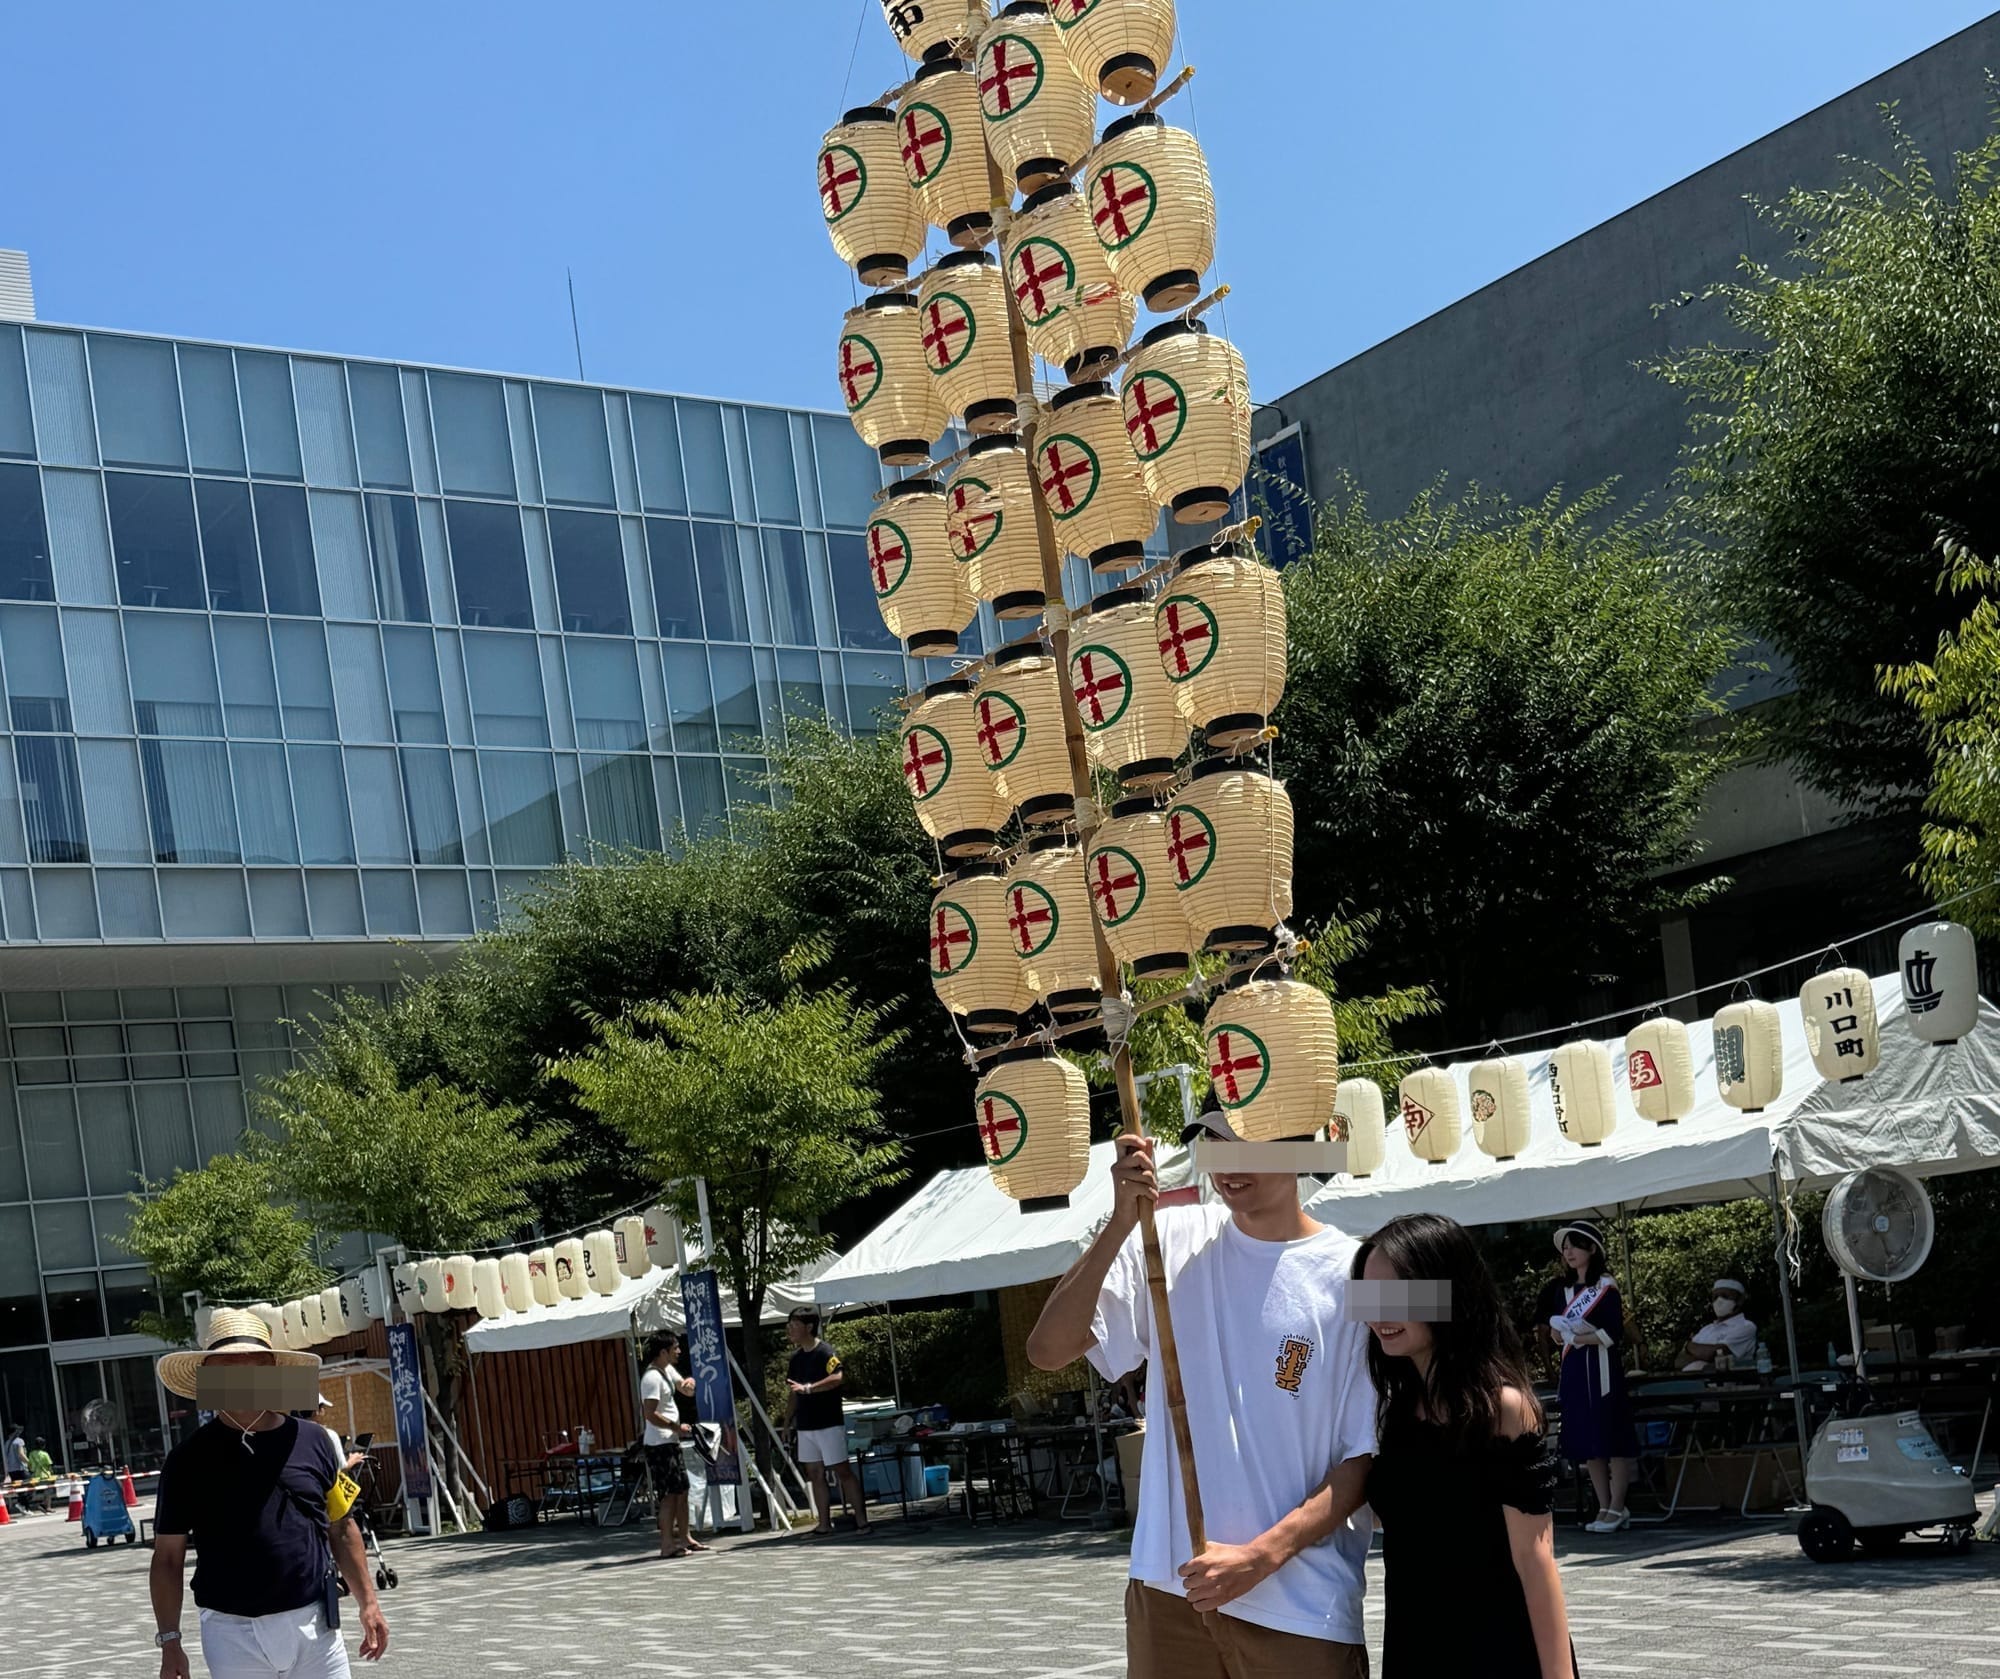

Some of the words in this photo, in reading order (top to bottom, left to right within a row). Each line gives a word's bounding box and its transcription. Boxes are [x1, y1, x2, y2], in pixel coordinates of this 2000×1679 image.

[1823, 986, 1866, 1059] 川口町
[1631, 1053, 1656, 1088] 馬
[1402, 1100, 1425, 1138] 南
